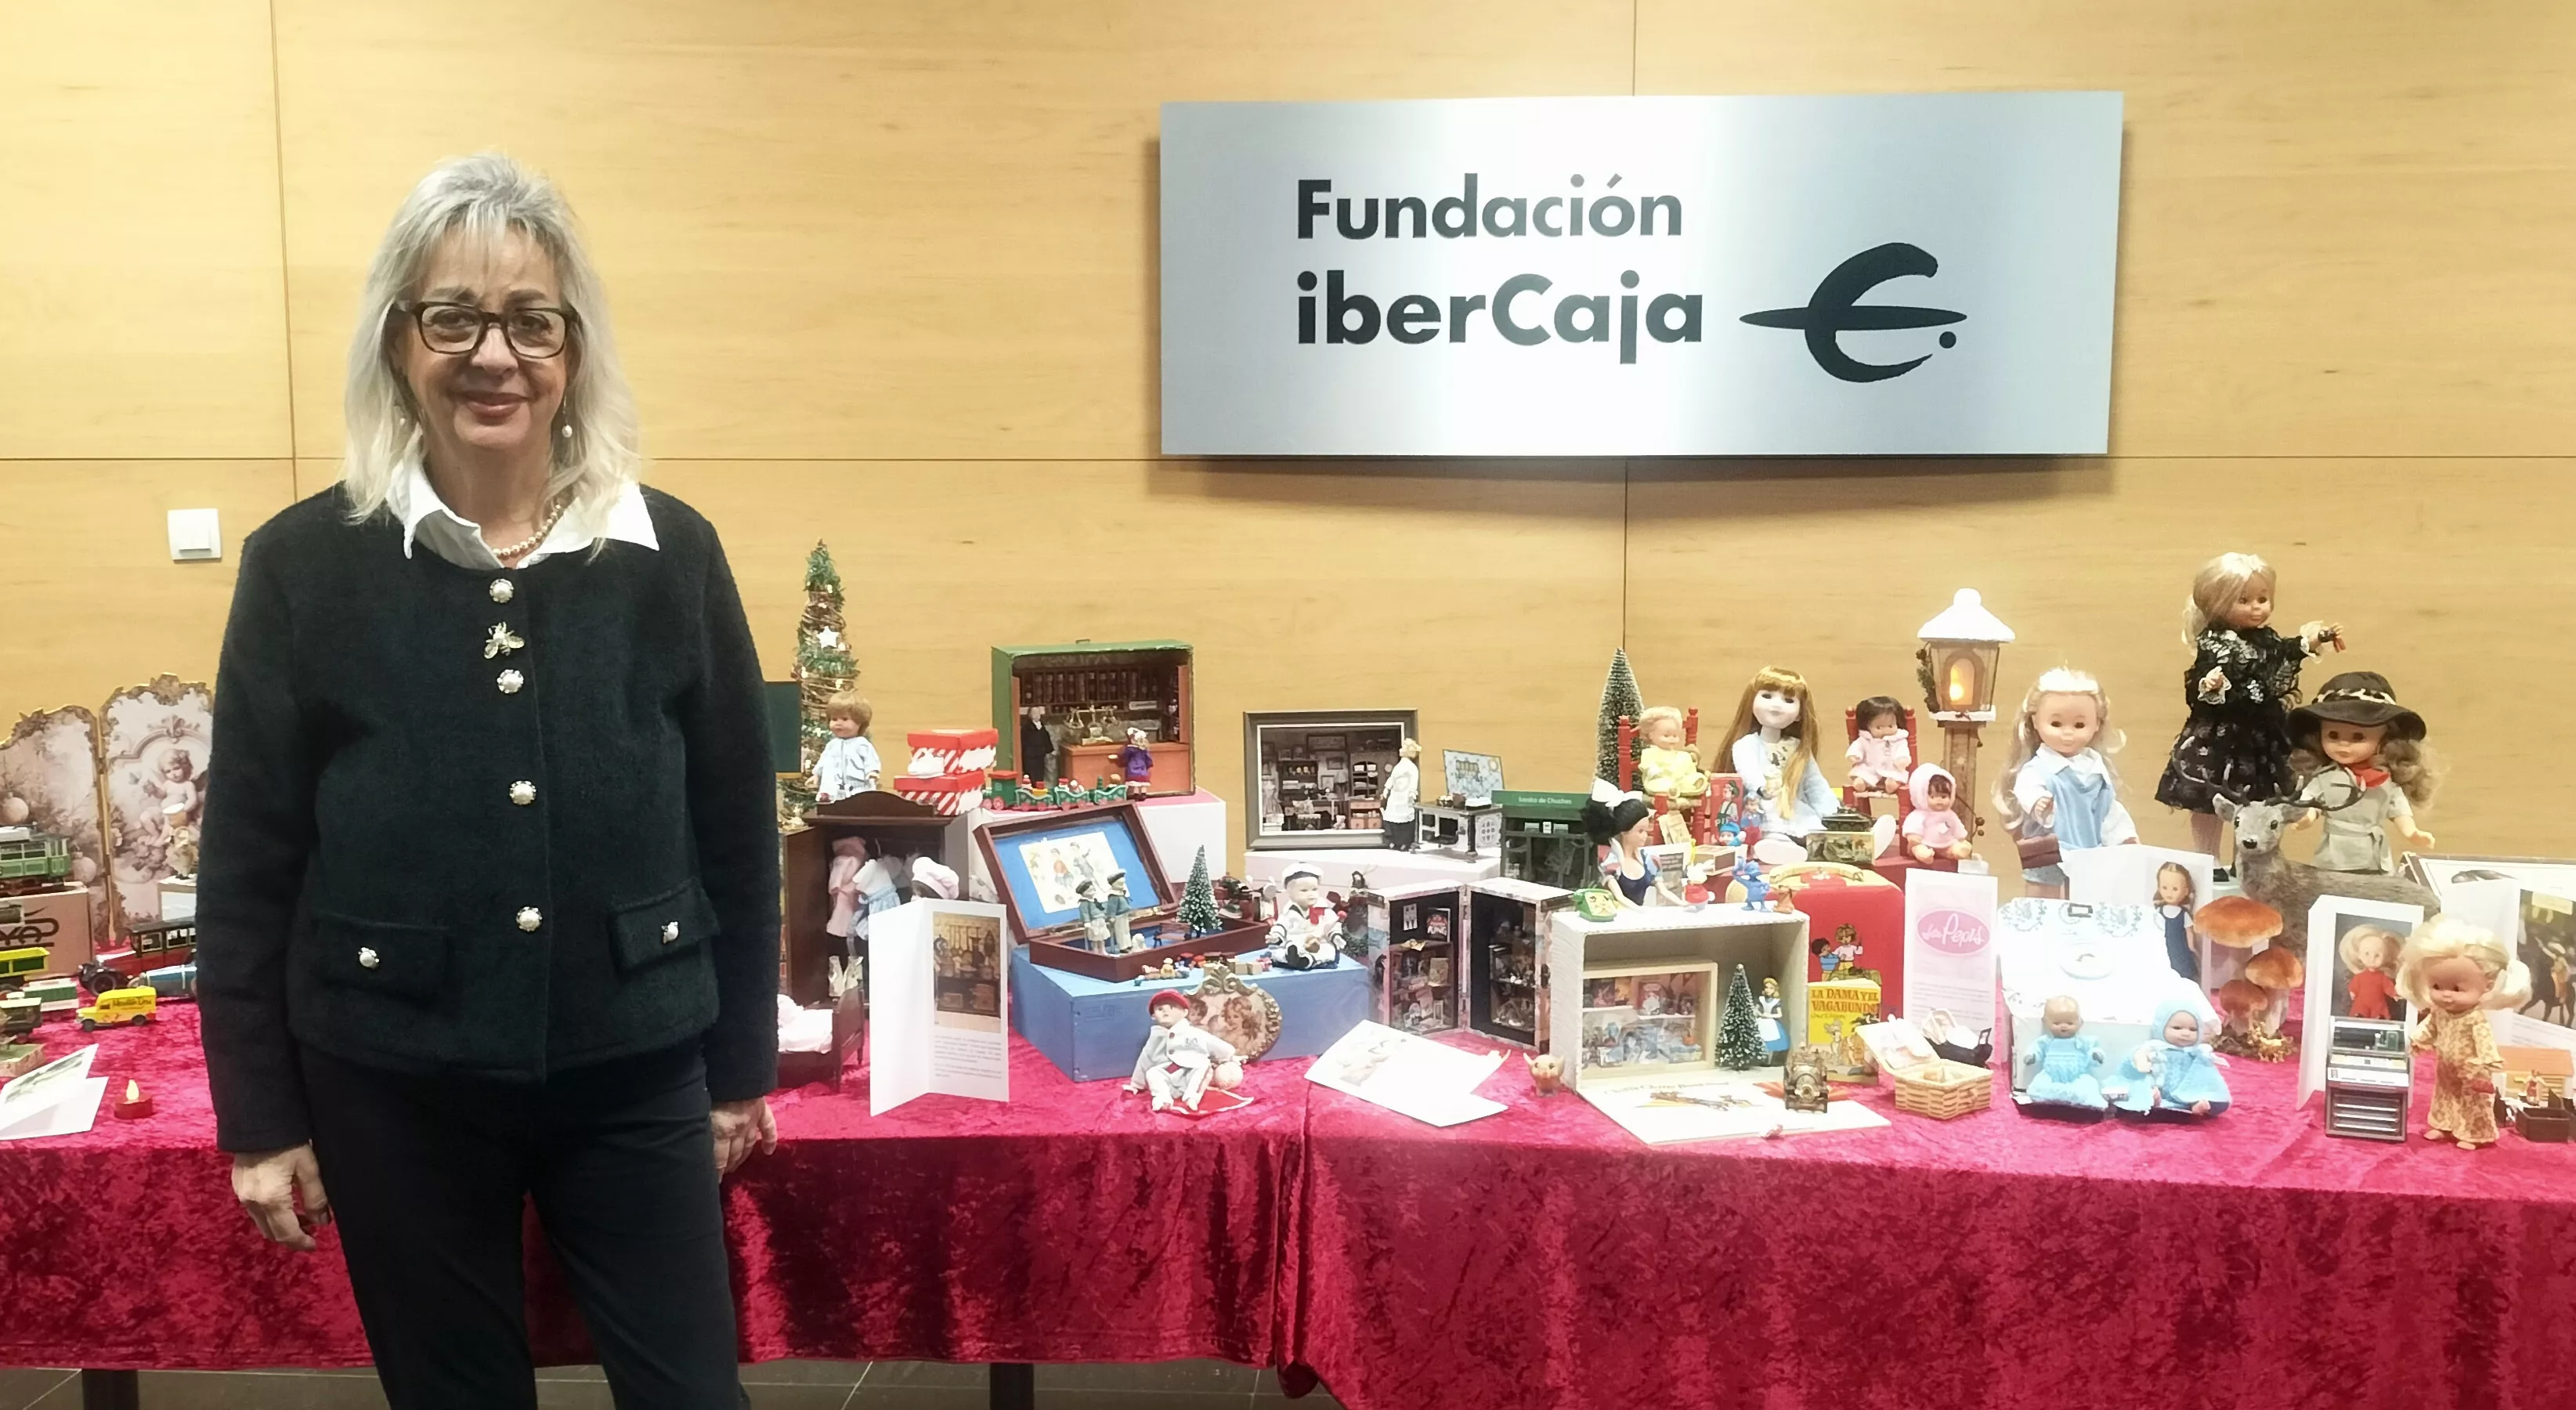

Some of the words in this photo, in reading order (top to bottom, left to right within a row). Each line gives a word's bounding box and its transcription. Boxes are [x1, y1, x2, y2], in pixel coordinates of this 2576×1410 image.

[1297, 172, 1682, 240] Fundación
[1296, 269, 1703, 364] iberCaja
[1811, 989, 1823, 999] LA
[1826, 988, 1859, 1000] DAMA
